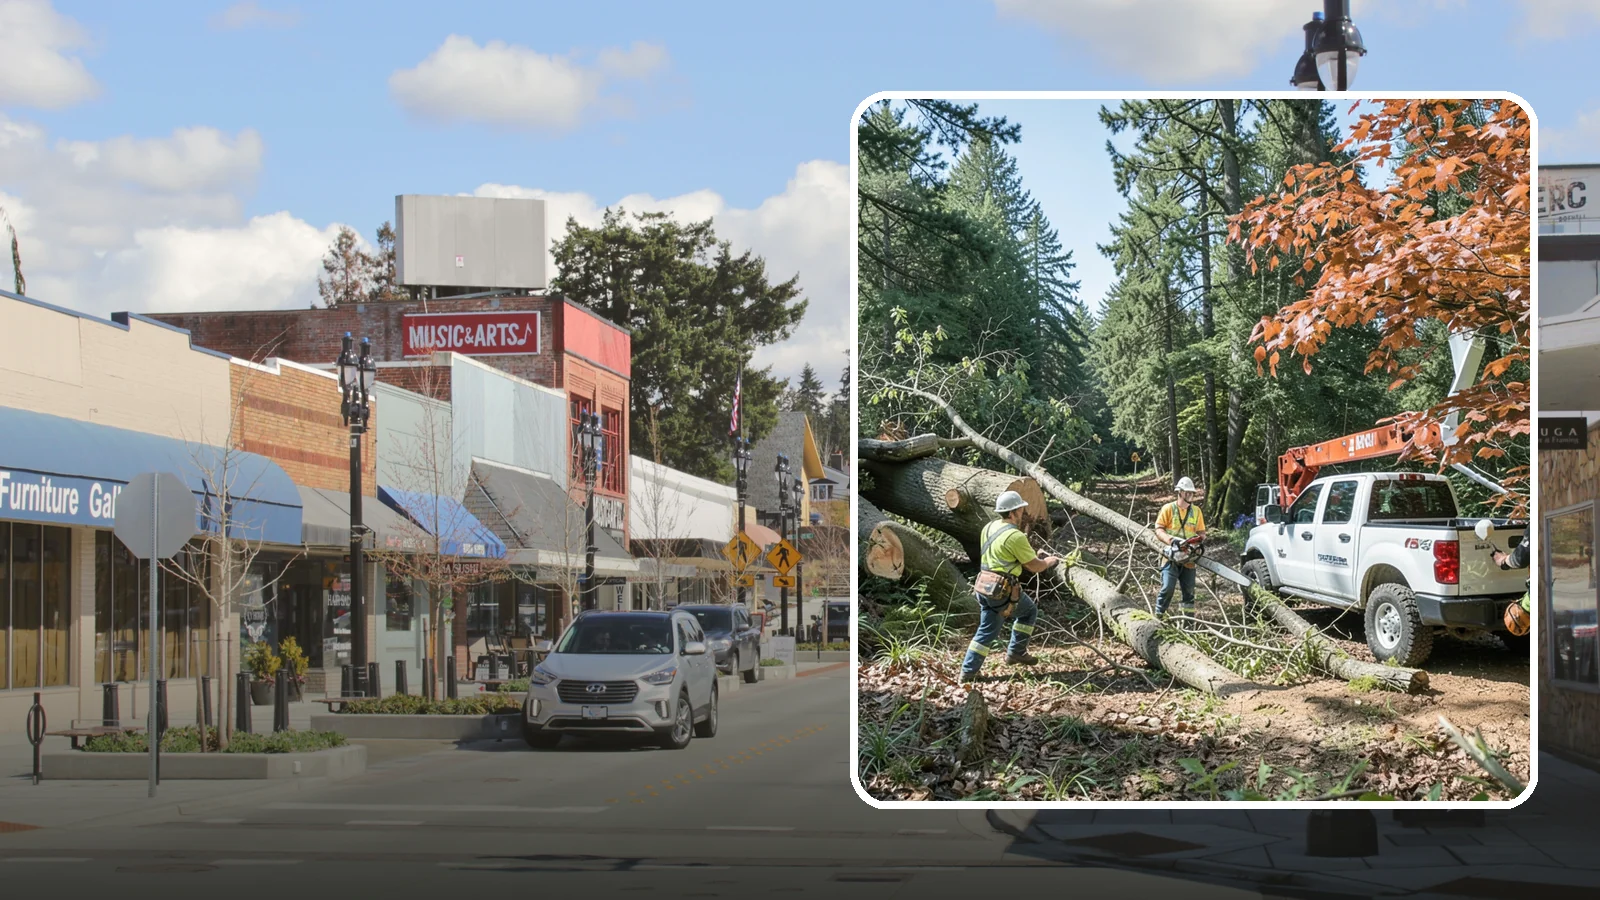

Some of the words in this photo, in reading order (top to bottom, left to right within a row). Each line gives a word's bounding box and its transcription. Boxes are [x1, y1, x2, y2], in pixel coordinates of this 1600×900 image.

[408, 322, 519, 349] MUSIC&ARTS
[0, 471, 79, 515] Furniture
[89, 482, 121, 519] Gal
[454, 563, 479, 574] SUSHI
